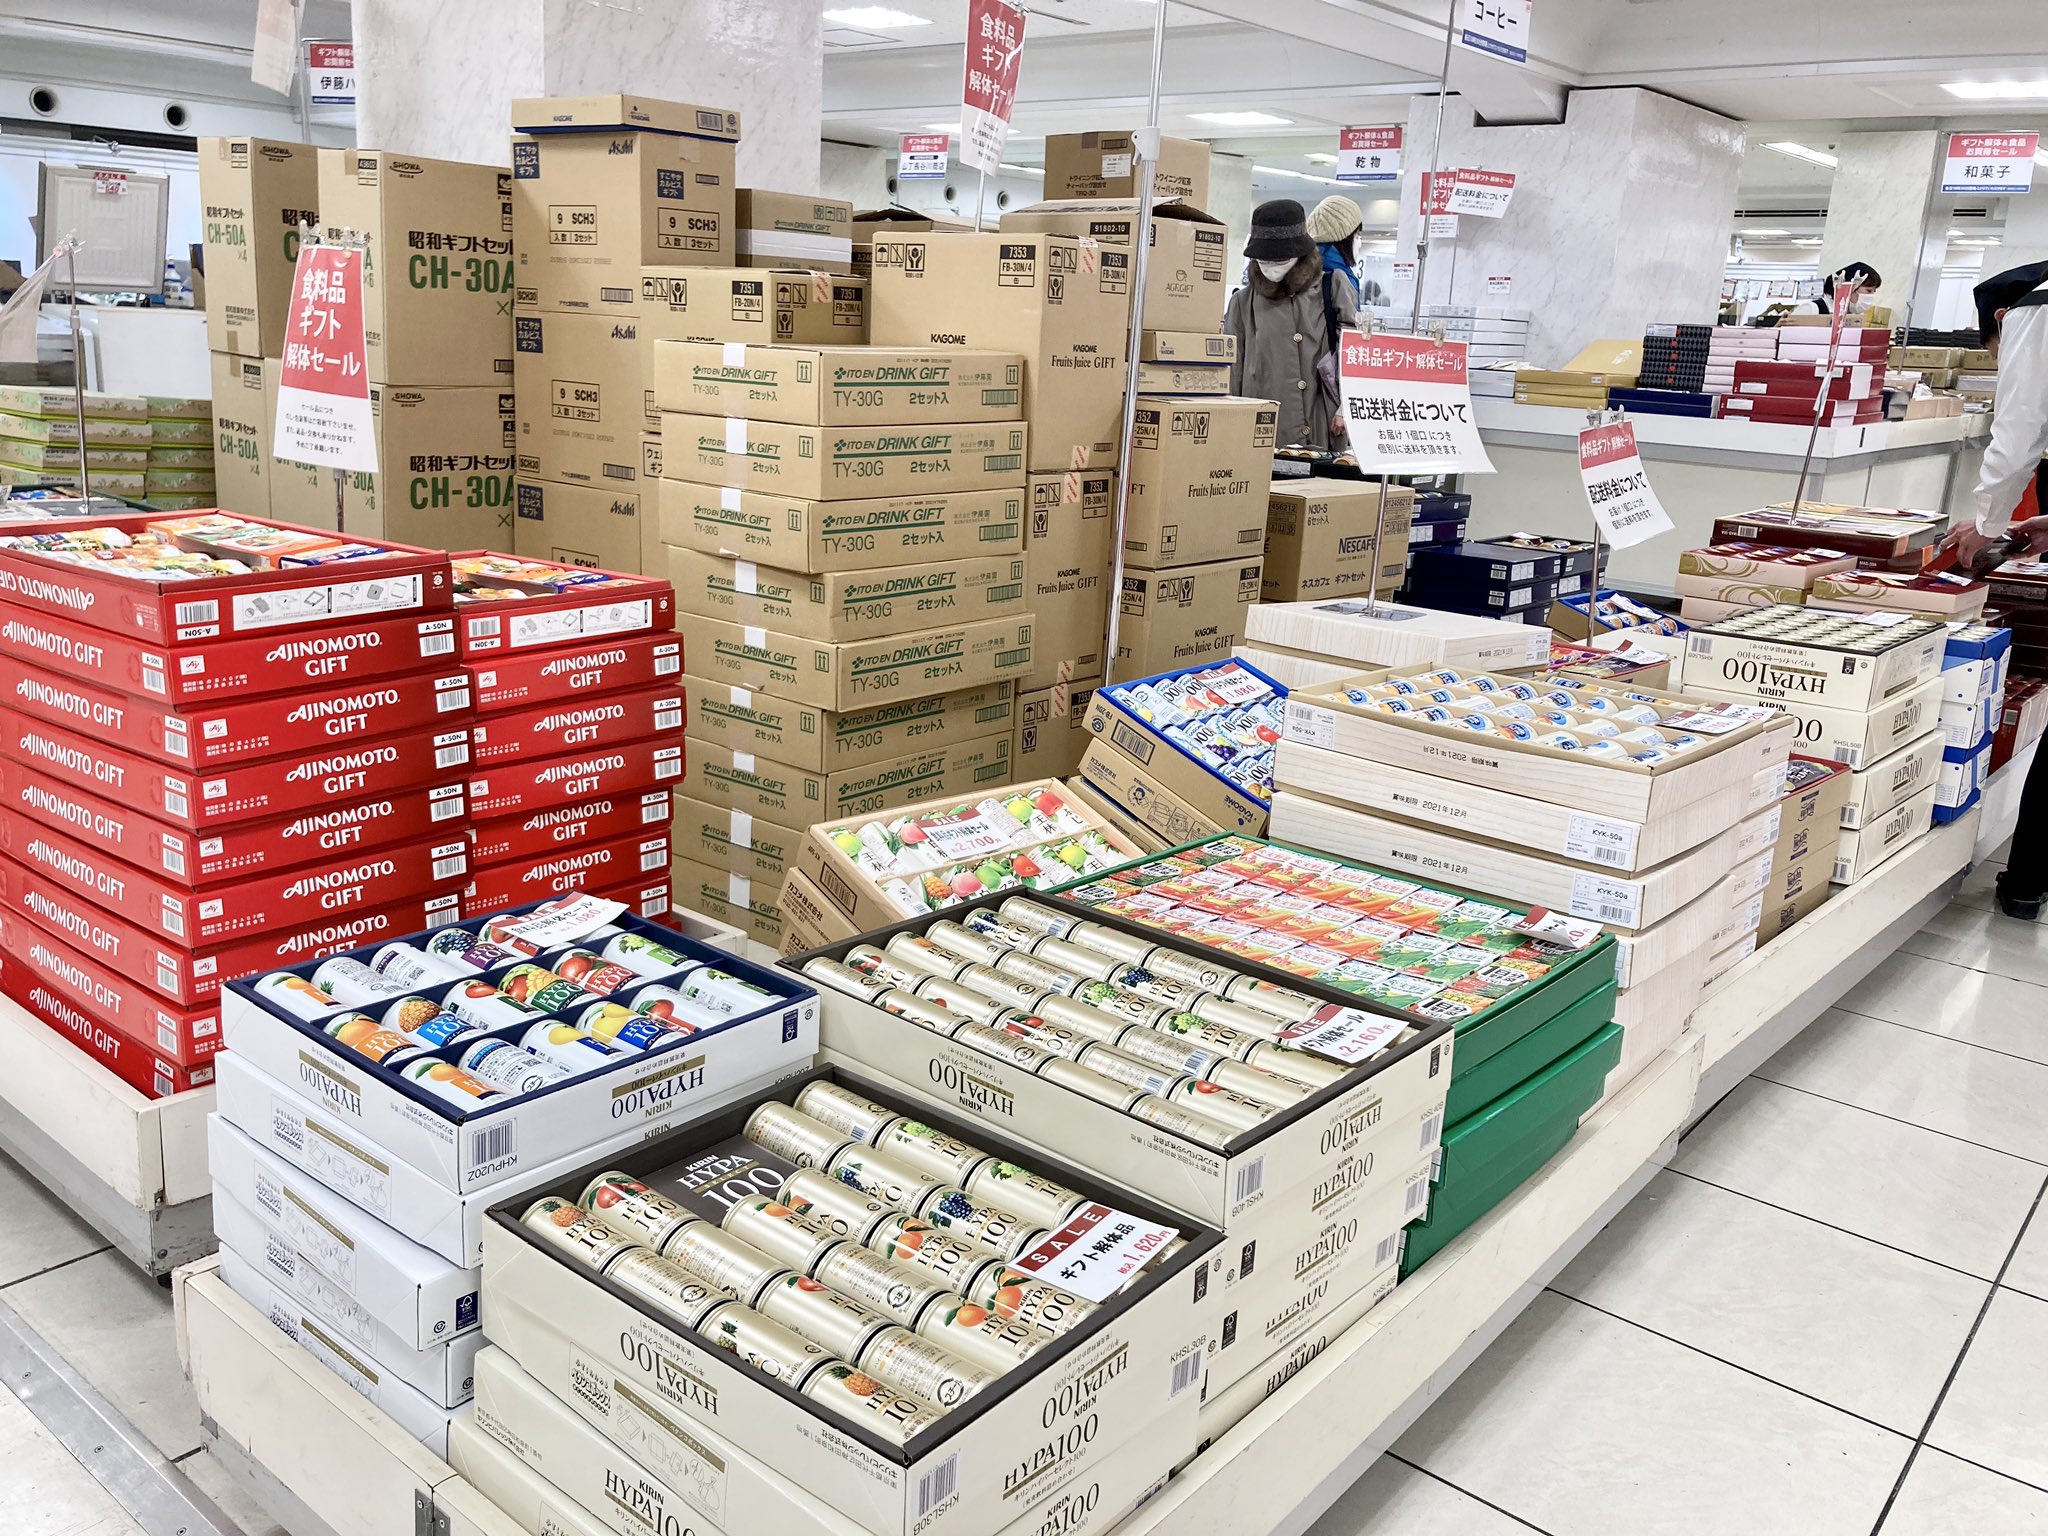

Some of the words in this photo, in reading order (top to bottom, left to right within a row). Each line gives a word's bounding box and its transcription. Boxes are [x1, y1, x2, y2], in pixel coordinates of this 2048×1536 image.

[1475, 1, 1517, 29] コーヒー
[980, 12, 1015, 50] 食料品
[608, 139, 634, 156] Asahi
[1355, 157, 1381, 169] 乾物
[1963, 165, 2011, 179] 和菓子
[1454, 188, 1510, 203] 配送料金について
[571, 213, 596, 225] SCH3
[687, 217, 718, 232] SCH3
[1094, 222, 1126, 233] 91802-10
[207, 223, 247, 247] CH-50A
[1008, 246, 1027, 259] 7353
[1002, 262, 1032, 273] FB-30N/4
[301, 267, 346, 305] 食料品
[738, 282, 756, 295] 7351
[299, 307, 342, 340] ギフト
[611, 324, 637, 340] Asahi
[930, 333, 966, 345] KAGOME
[1072, 344, 1098, 353] KAGOME
[285, 342, 361, 375] 解体セール
[1051, 355, 1074, 368] Fruits
[1073, 356, 1092, 369] Juice
[1093, 356, 1116, 369] GIFT
[1345, 344, 1414, 370] 食料品ギフト
[1415, 351, 1464, 372] 解体セール
[720, 367, 752, 380] DRINK
[753, 370, 778, 383] GIFT
[846, 368, 861, 379] ITO
[863, 369, 875, 378] EN
[876, 367, 918, 380] DRINK
[920, 367, 950, 380] GIFT
[692, 383, 720, 397] TY-30G
[749, 388, 778, 402] 2セット入
[832, 390, 884, 407] TY-30G
[909, 392, 950, 405] 2セット入
[1348, 396, 1468, 424] 配送料金について
[846, 439, 862, 450] ITO
[863, 440, 876, 449] EN
[876, 436, 919, 450] DRINK
[921, 435, 952, 449] GIFT
[1378, 429, 1403, 441] お届け
[1580, 439, 1613, 460] 食料品ギフト
[832, 460, 884, 478] TY-30G
[910, 459, 951, 474] 2セット入
[1209, 469, 1233, 479] KAGOME
[1188, 484, 1209, 498] Fruits
[1209, 482, 1227, 499] Juice
[1228, 480, 1250, 495] GIFT
[1587, 471, 1648, 505] 配送料金について
[1308, 503, 1328, 515] N30-S
[1307, 516, 1330, 527] 6セット入
[885, 575, 926, 593] DRINK
[927, 571, 957, 587] GIFT
[1301, 577, 1331, 589] ネスカフェ
[1334, 571, 1366, 585] ギフトセット
[843, 602, 893, 622] TY-30G
[916, 596, 956, 611] 2セット入
[424, 619, 448, 631] A-50N
[2, 619, 73, 658] AJINOMOTO
[74, 643, 104, 668] GIFT
[265, 631, 383, 663] AJINOMOTO
[658, 645, 676, 655] A-30N
[304, 655, 350, 677] GIFT
[541, 650, 627, 677] AJINOMOTO
[569, 671, 602, 689] GIFT
[1756, 686, 1786, 698] KIRIN
[16, 676, 91, 720] AJINOMOTO
[92, 703, 124, 730] GIFT
[285, 746, 399, 782] AJINOMOTO
[322, 771, 367, 794] GIFT
[1421, 800, 1468, 819] 2021年12月
[933, 813, 963, 827] SALE
[1591, 828, 1624, 843] KYK-50a
[1289, 1017, 1327, 1036] SALE
[644, 1100, 673, 1118] KIRIN
[675, 1153, 753, 1191] HYPA
[685, 1153, 720, 1173] KIRIN
[1336, 1154, 1355, 1171] KIRIN
[702, 1166, 785, 1213] 100
[1030, 1210, 1102, 1265] SALE
[1059, 1222, 1137, 1281] ギフト解体品
[1019, 1285, 1053, 1326] HYPA
[1036, 1292, 1076, 1337] 100
[1169, 1334, 1208, 1364] KHSL30B
[638, 1479, 665, 1505] KIRIN
[1046, 1492, 1072, 1519] KIRIN
